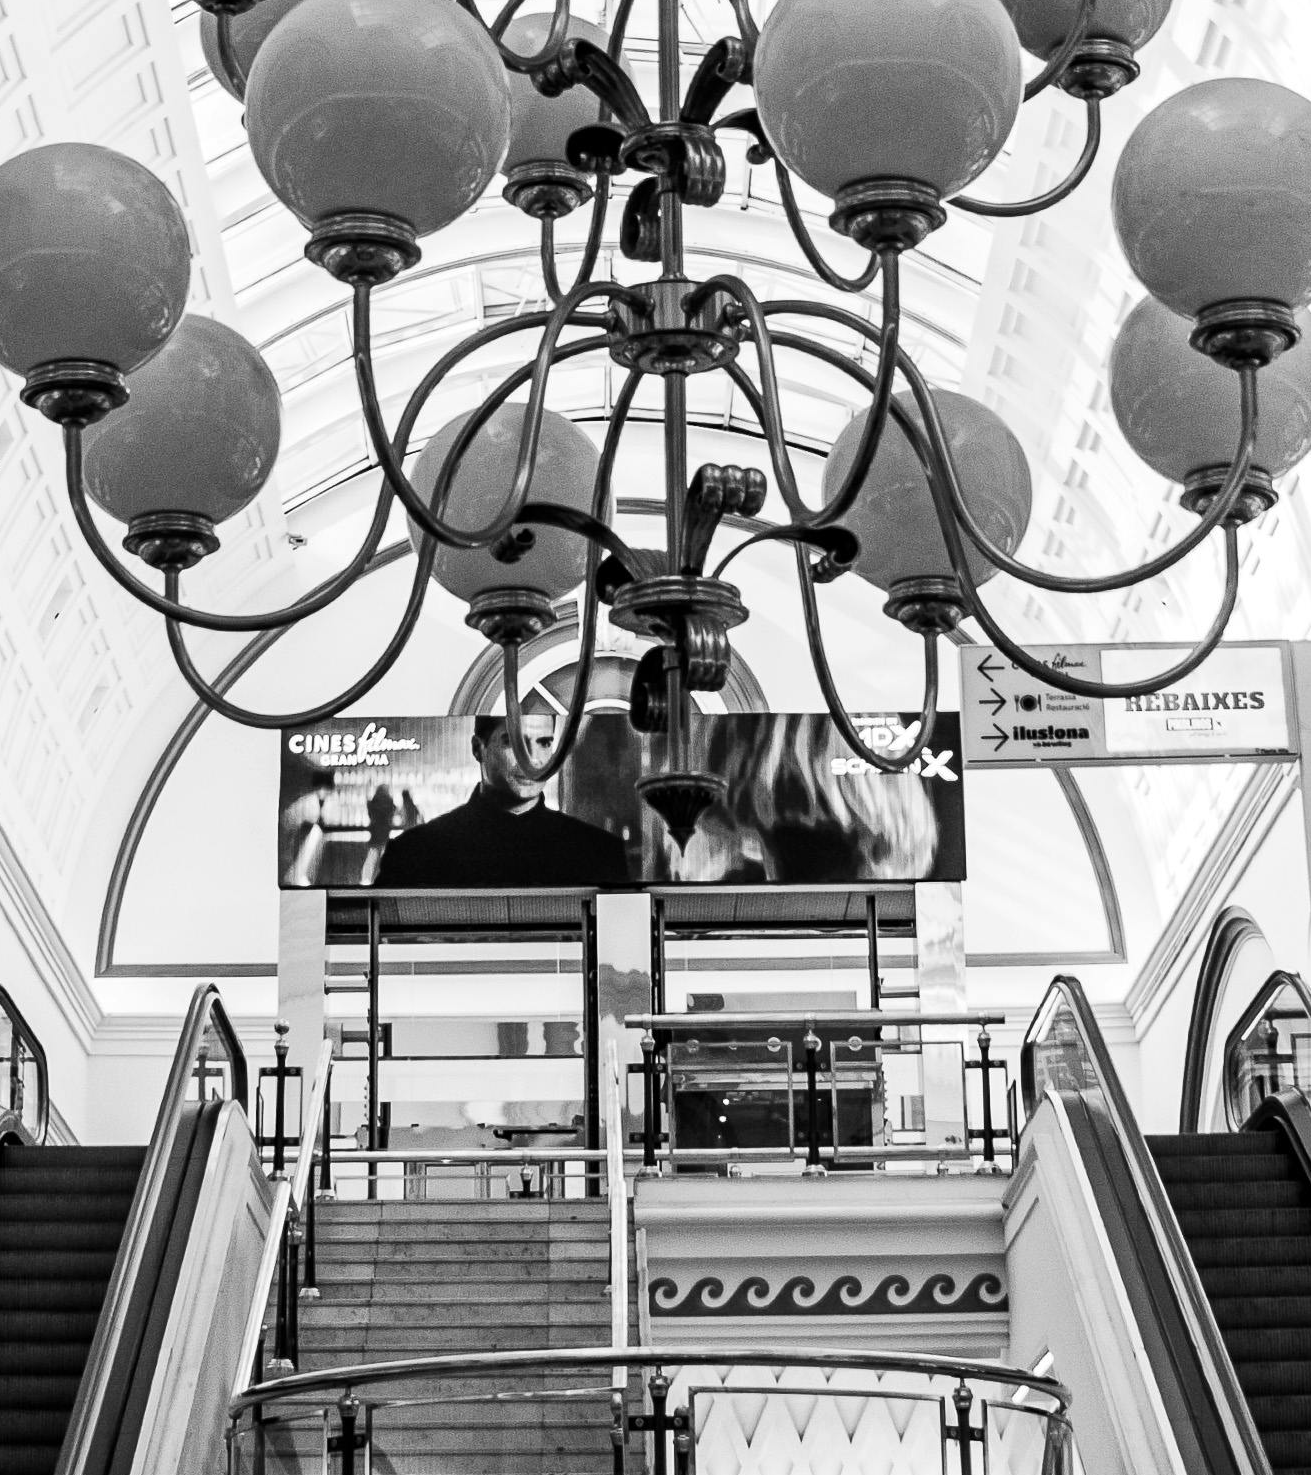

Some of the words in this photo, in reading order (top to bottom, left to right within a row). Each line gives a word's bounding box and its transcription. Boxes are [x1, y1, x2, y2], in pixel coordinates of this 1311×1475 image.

[1124, 691, 1265, 712] REBAIXES
[289, 734, 356, 754] CINES
[320, 754, 357, 767] GRAN
[365, 753, 389, 766] VIA
